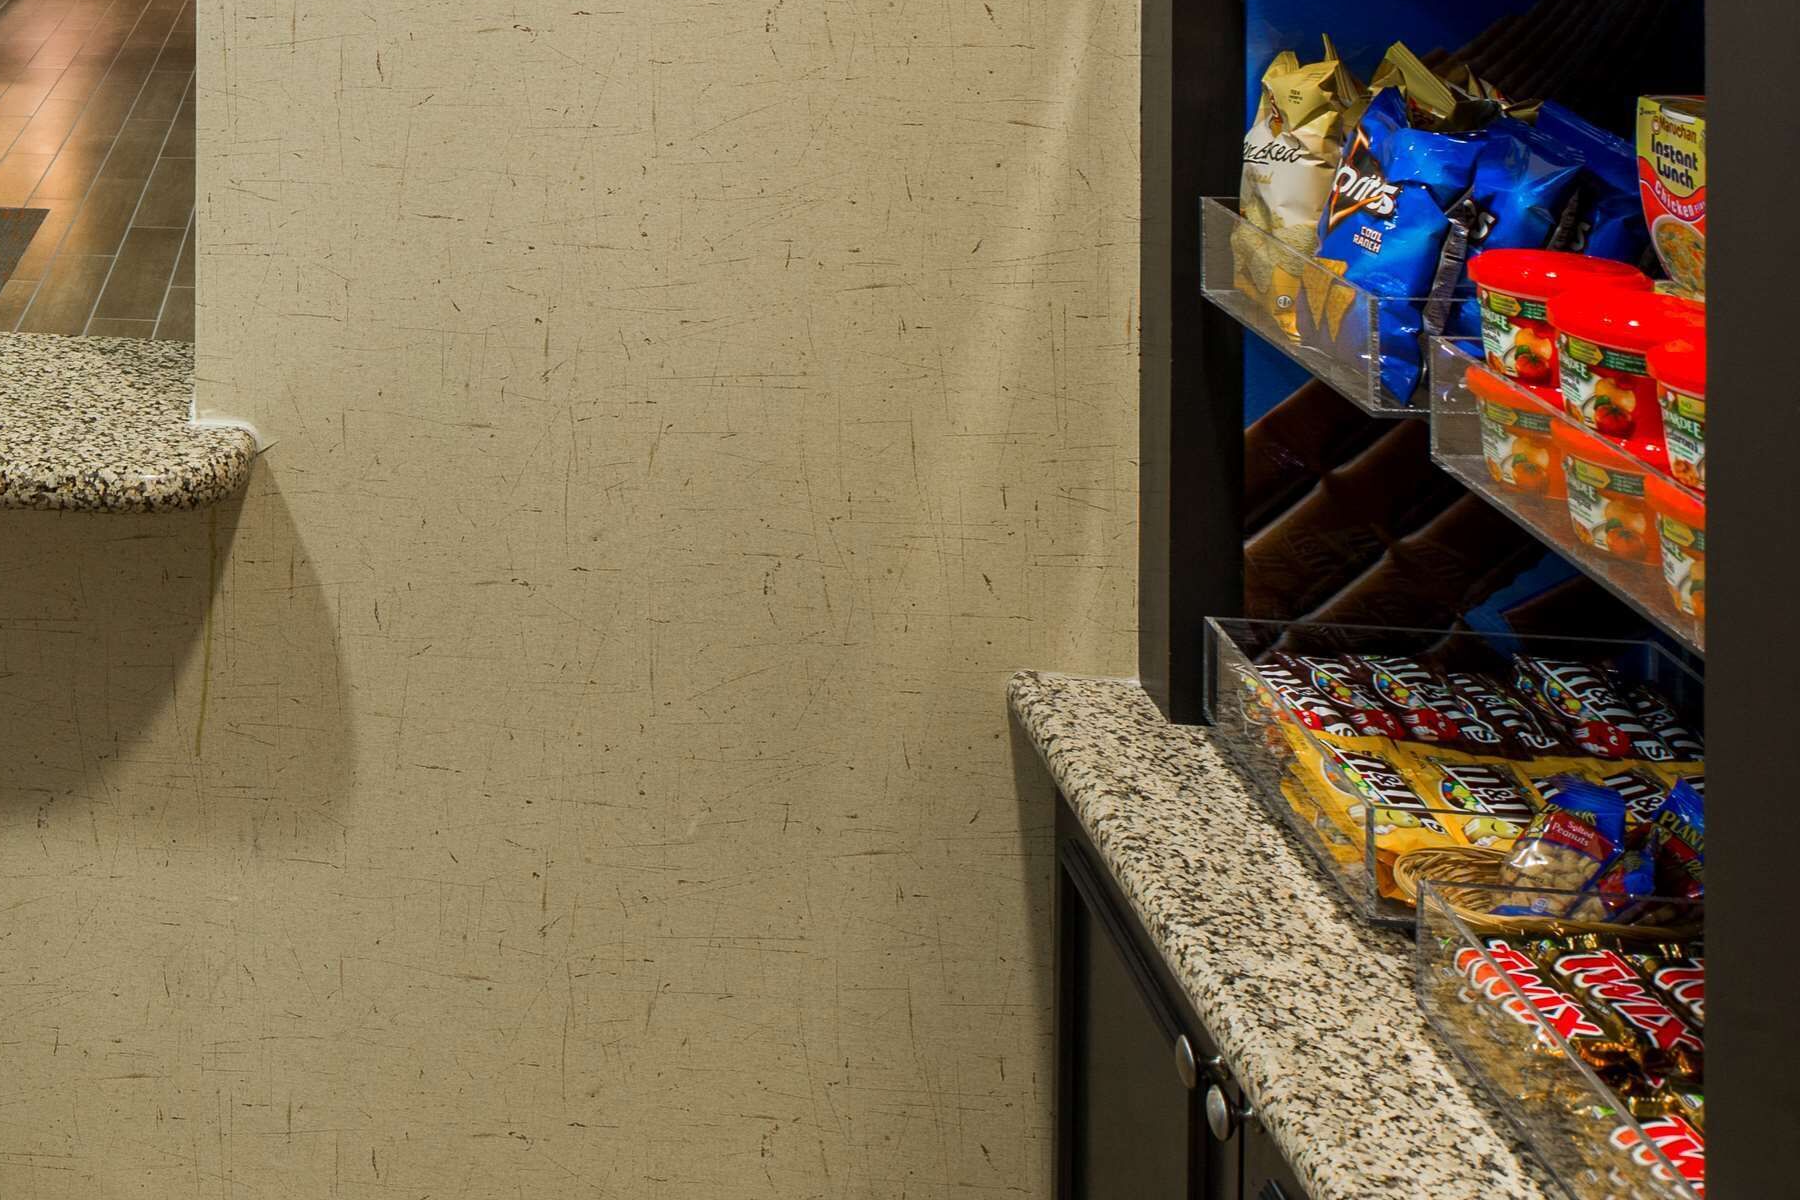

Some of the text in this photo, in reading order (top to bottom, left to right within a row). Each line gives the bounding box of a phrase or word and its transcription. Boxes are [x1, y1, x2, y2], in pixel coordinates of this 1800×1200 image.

[1659, 116, 1697, 145] Maruchan
[1651, 133, 1698, 172] Instant
[1656, 156, 1694, 190] Lunch
[1654, 180, 1695, 218] Chicken
[1352, 233, 1382, 254] RANCH
[1361, 225, 1383, 243] COOL
[1552, 822, 1590, 847] Peanuts
[1566, 819, 1595, 839] Salted
[1553, 948, 1705, 1051] TWIX
